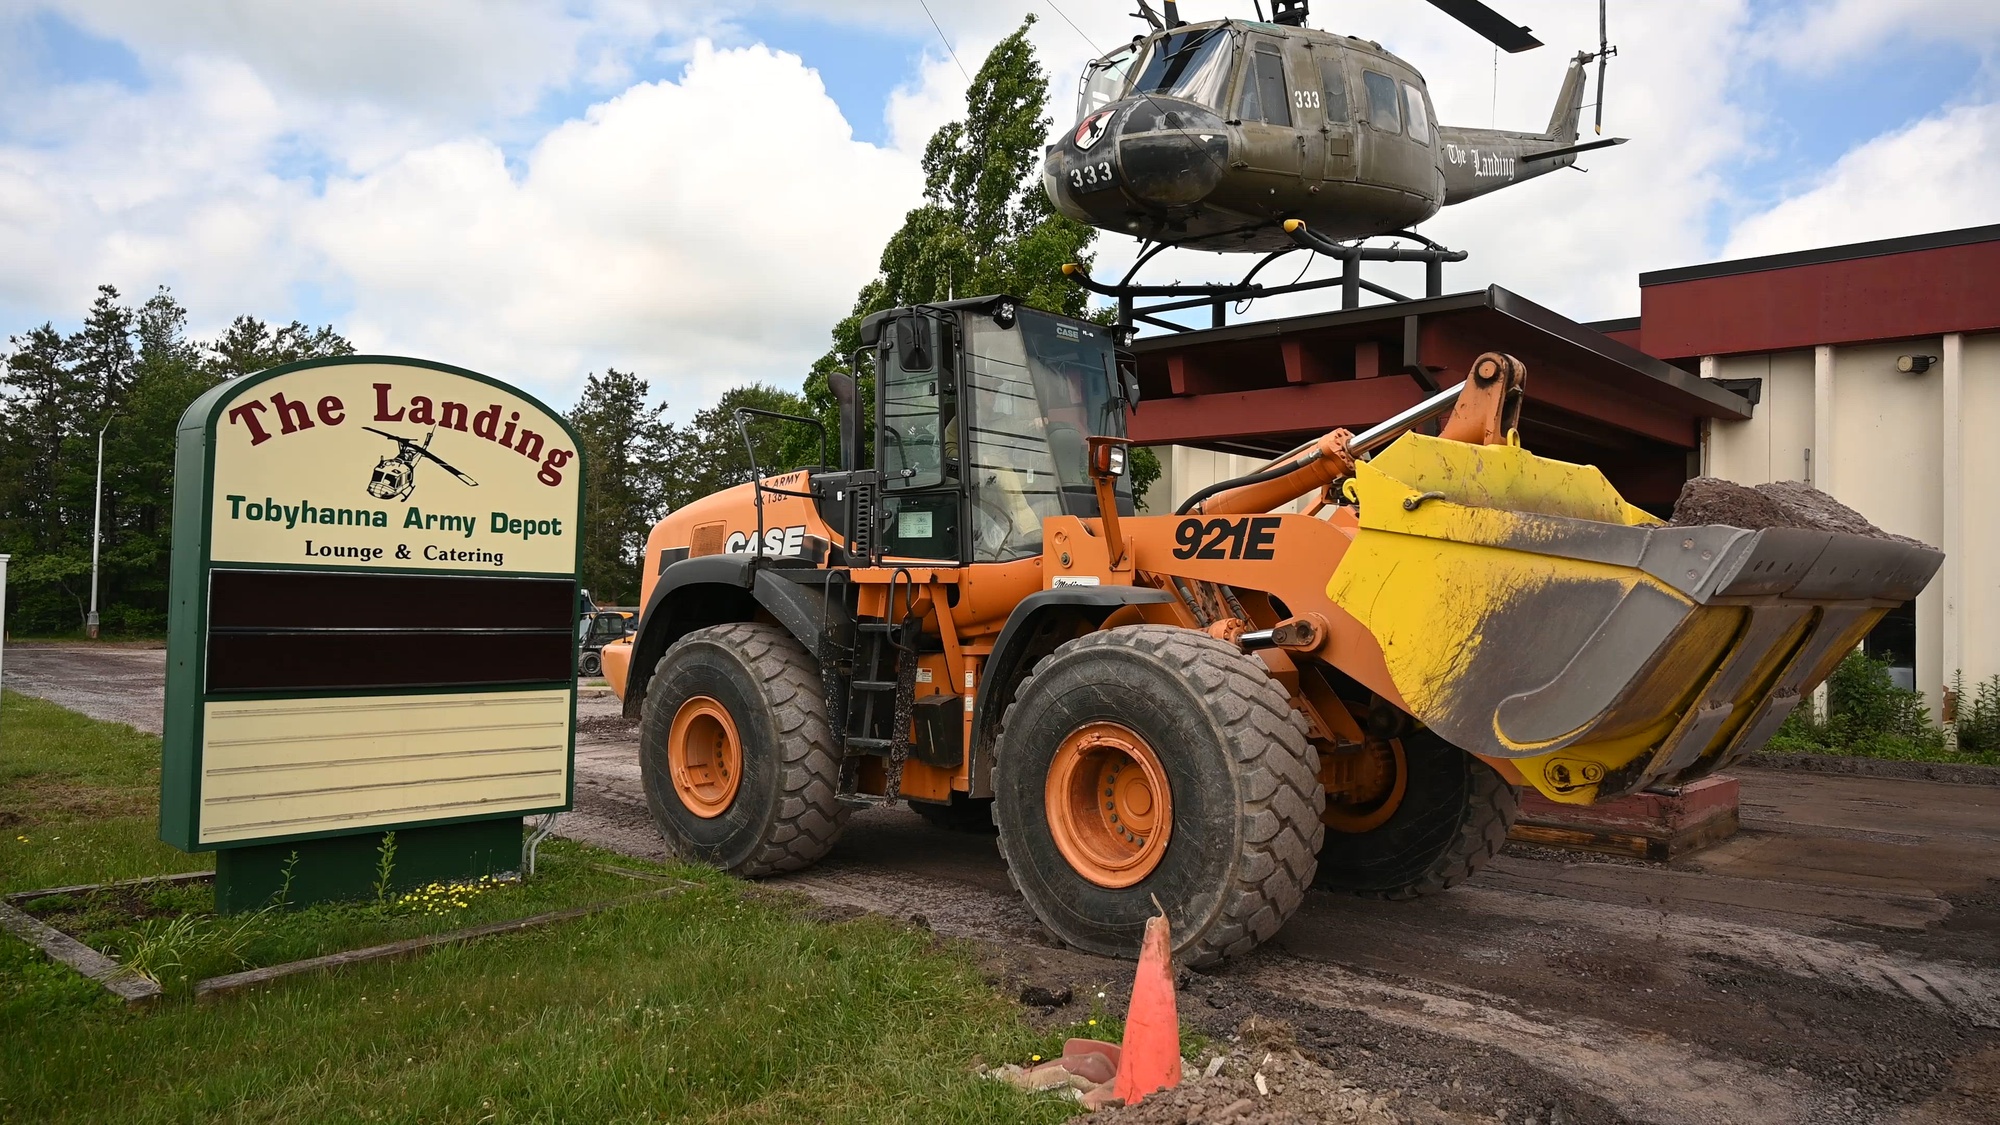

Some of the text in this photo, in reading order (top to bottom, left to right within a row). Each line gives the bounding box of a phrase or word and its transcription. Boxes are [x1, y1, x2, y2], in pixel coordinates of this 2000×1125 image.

[1294, 90, 1320, 109] 333
[1070, 162, 1113, 188] 333
[1447, 143, 1515, 181] The Landing
[1056, 327, 1079, 339] CASE
[229, 383, 574, 487] The Landing
[773, 473, 801, 488] ARMY
[226, 495, 562, 540] Tobyhanna Army Depot
[725, 525, 806, 556] CASE
[1172, 516, 1282, 560] 921E
[305, 540, 504, 566] Lounge & Catering
